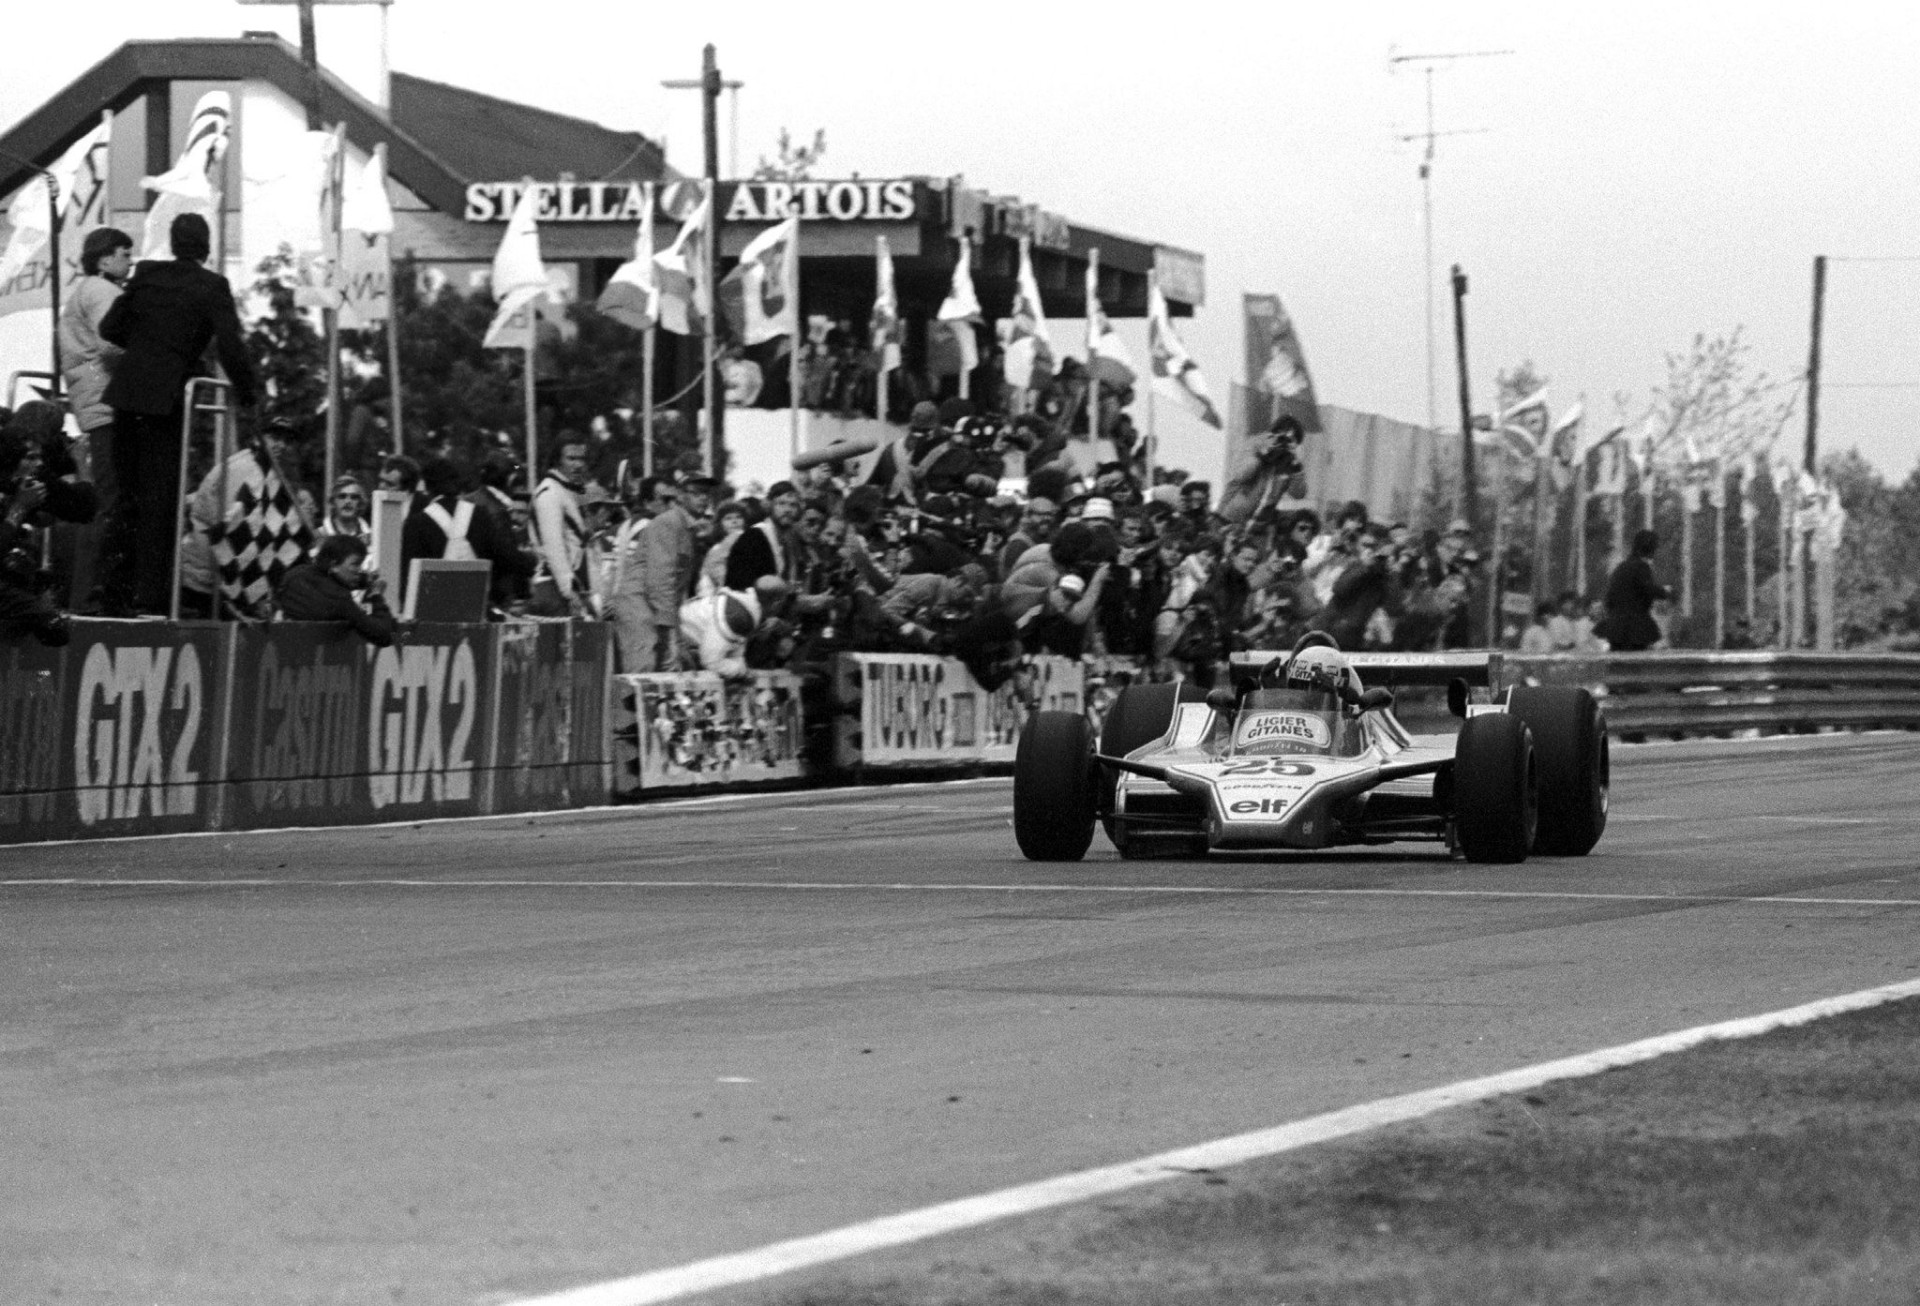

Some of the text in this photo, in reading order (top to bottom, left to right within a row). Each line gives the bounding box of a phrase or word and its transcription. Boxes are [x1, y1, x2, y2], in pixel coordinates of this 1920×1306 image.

[465, 181, 915, 221] STELLA ARTOIS
[1256, 717, 1307, 727] LIGIER
[1248, 725, 1314, 739] GITANES
[1218, 760, 1316, 777] 25
[1230, 799, 1288, 814] elf
